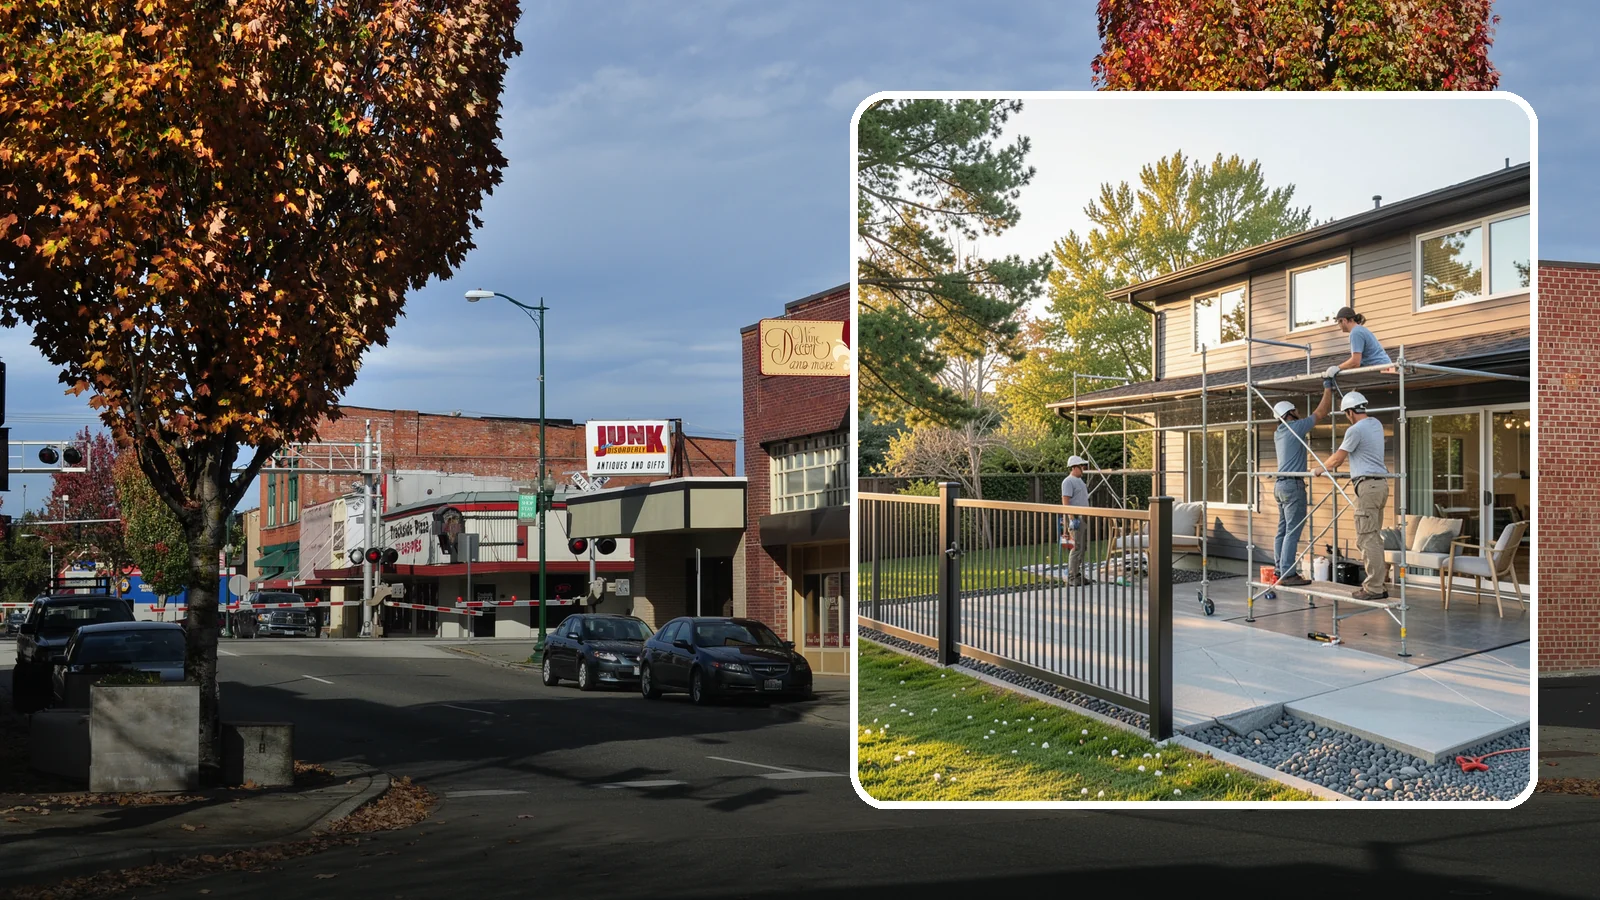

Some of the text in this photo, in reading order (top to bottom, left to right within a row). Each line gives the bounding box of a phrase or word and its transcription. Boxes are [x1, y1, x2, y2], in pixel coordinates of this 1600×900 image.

[596, 425, 665, 457] JUNK
[607, 446, 646, 454] DISORDERLY
[597, 460, 666, 470] ANTIQUES AND GIFTS
